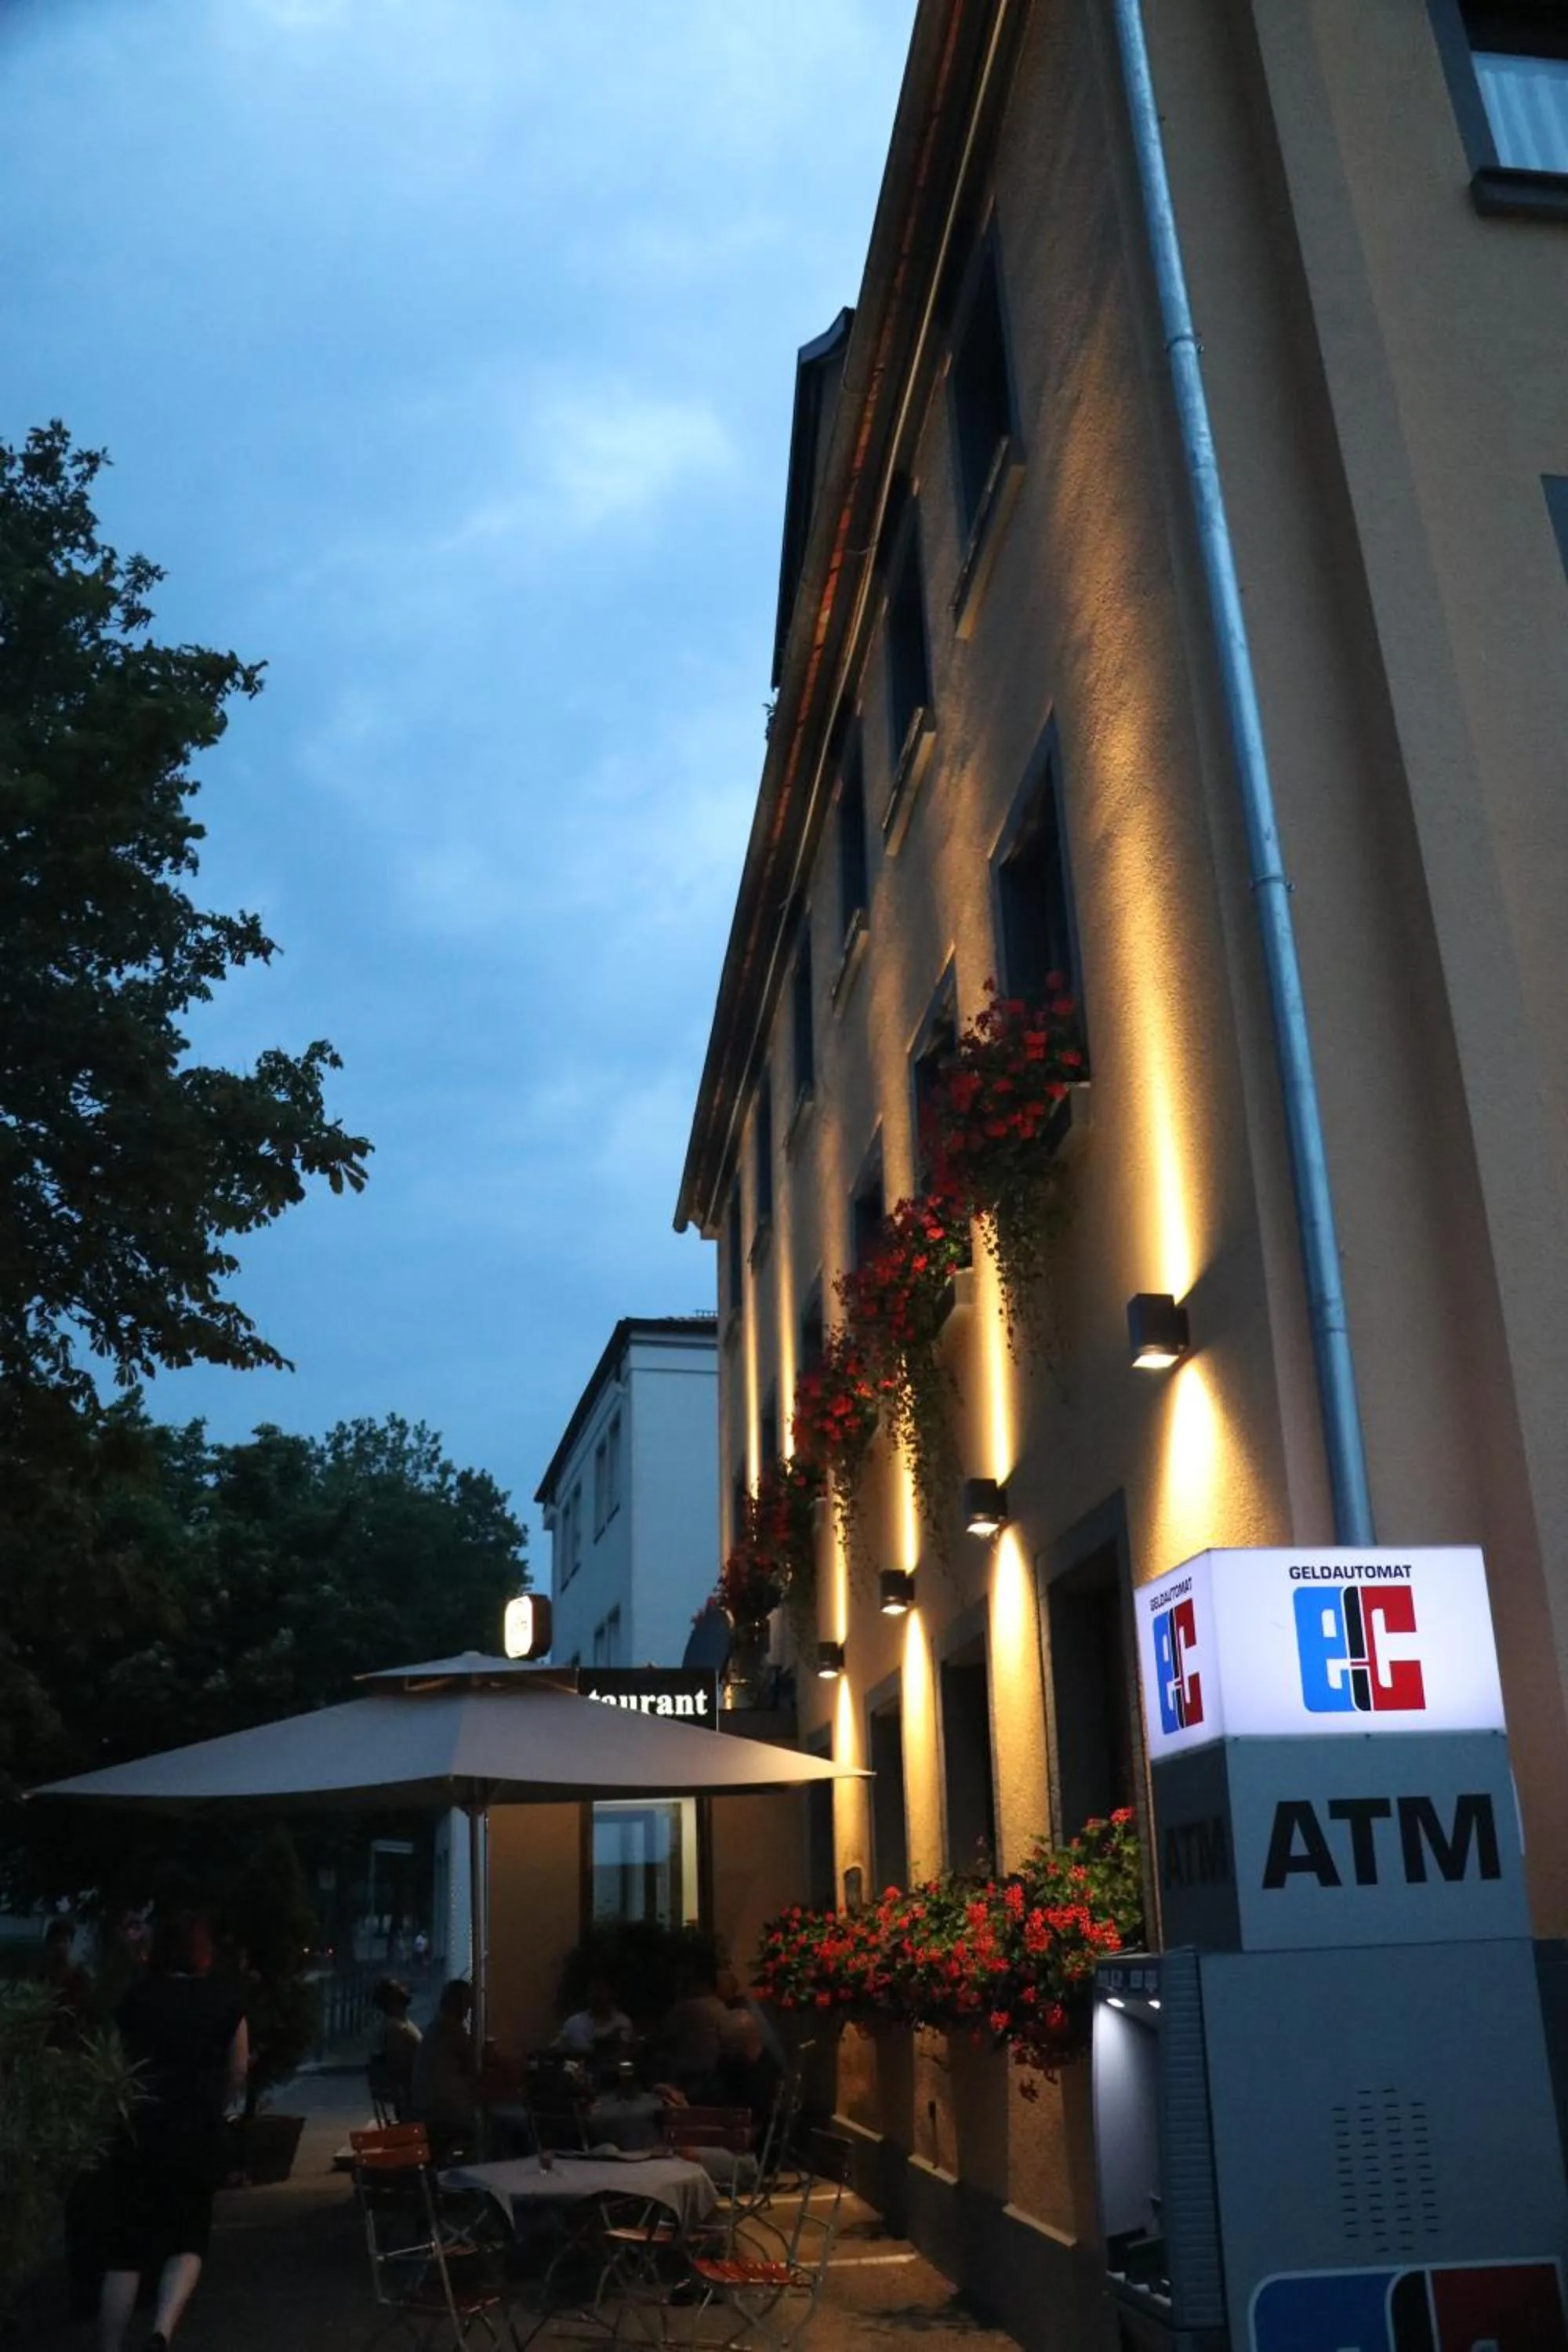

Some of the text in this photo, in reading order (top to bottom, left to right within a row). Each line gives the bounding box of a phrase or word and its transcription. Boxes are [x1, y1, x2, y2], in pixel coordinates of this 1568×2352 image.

[1149, 1577, 1192, 1612] GELDAUTOMAT
[1289, 1564, 1412, 1581] GELDAUTOMAT
[1163, 1815, 1228, 1890] ATM
[1262, 1793, 1502, 1890] ATM
